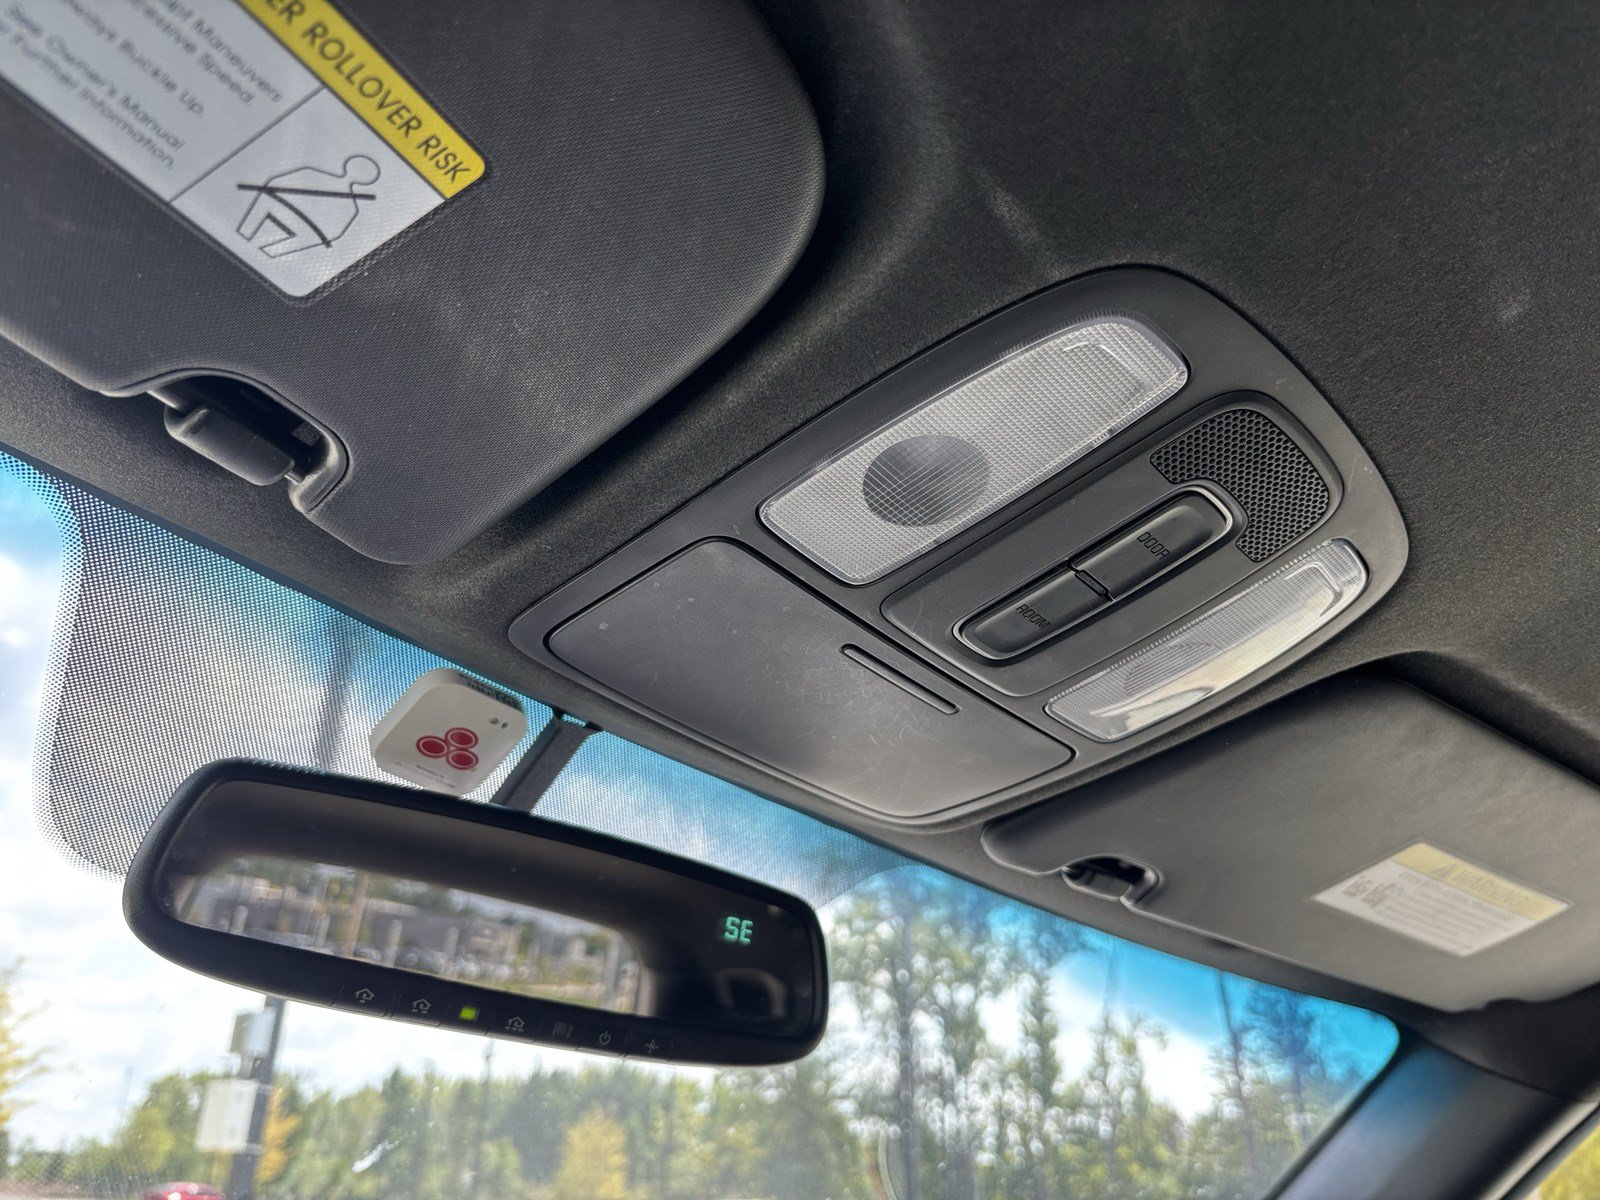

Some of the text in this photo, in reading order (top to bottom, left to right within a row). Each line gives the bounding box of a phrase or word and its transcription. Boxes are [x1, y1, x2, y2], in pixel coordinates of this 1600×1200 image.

[117, 37, 178, 93] Buckle
[191, 16, 283, 102] Maneuvers
[119, 94, 186, 150] Manual
[303, 20, 423, 139] ROLLOVER
[416, 134, 471, 183] RISK
[1137, 531, 1170, 560] DOOR
[1015, 604, 1050, 629] ROOM
[724, 916, 753, 945] SE
